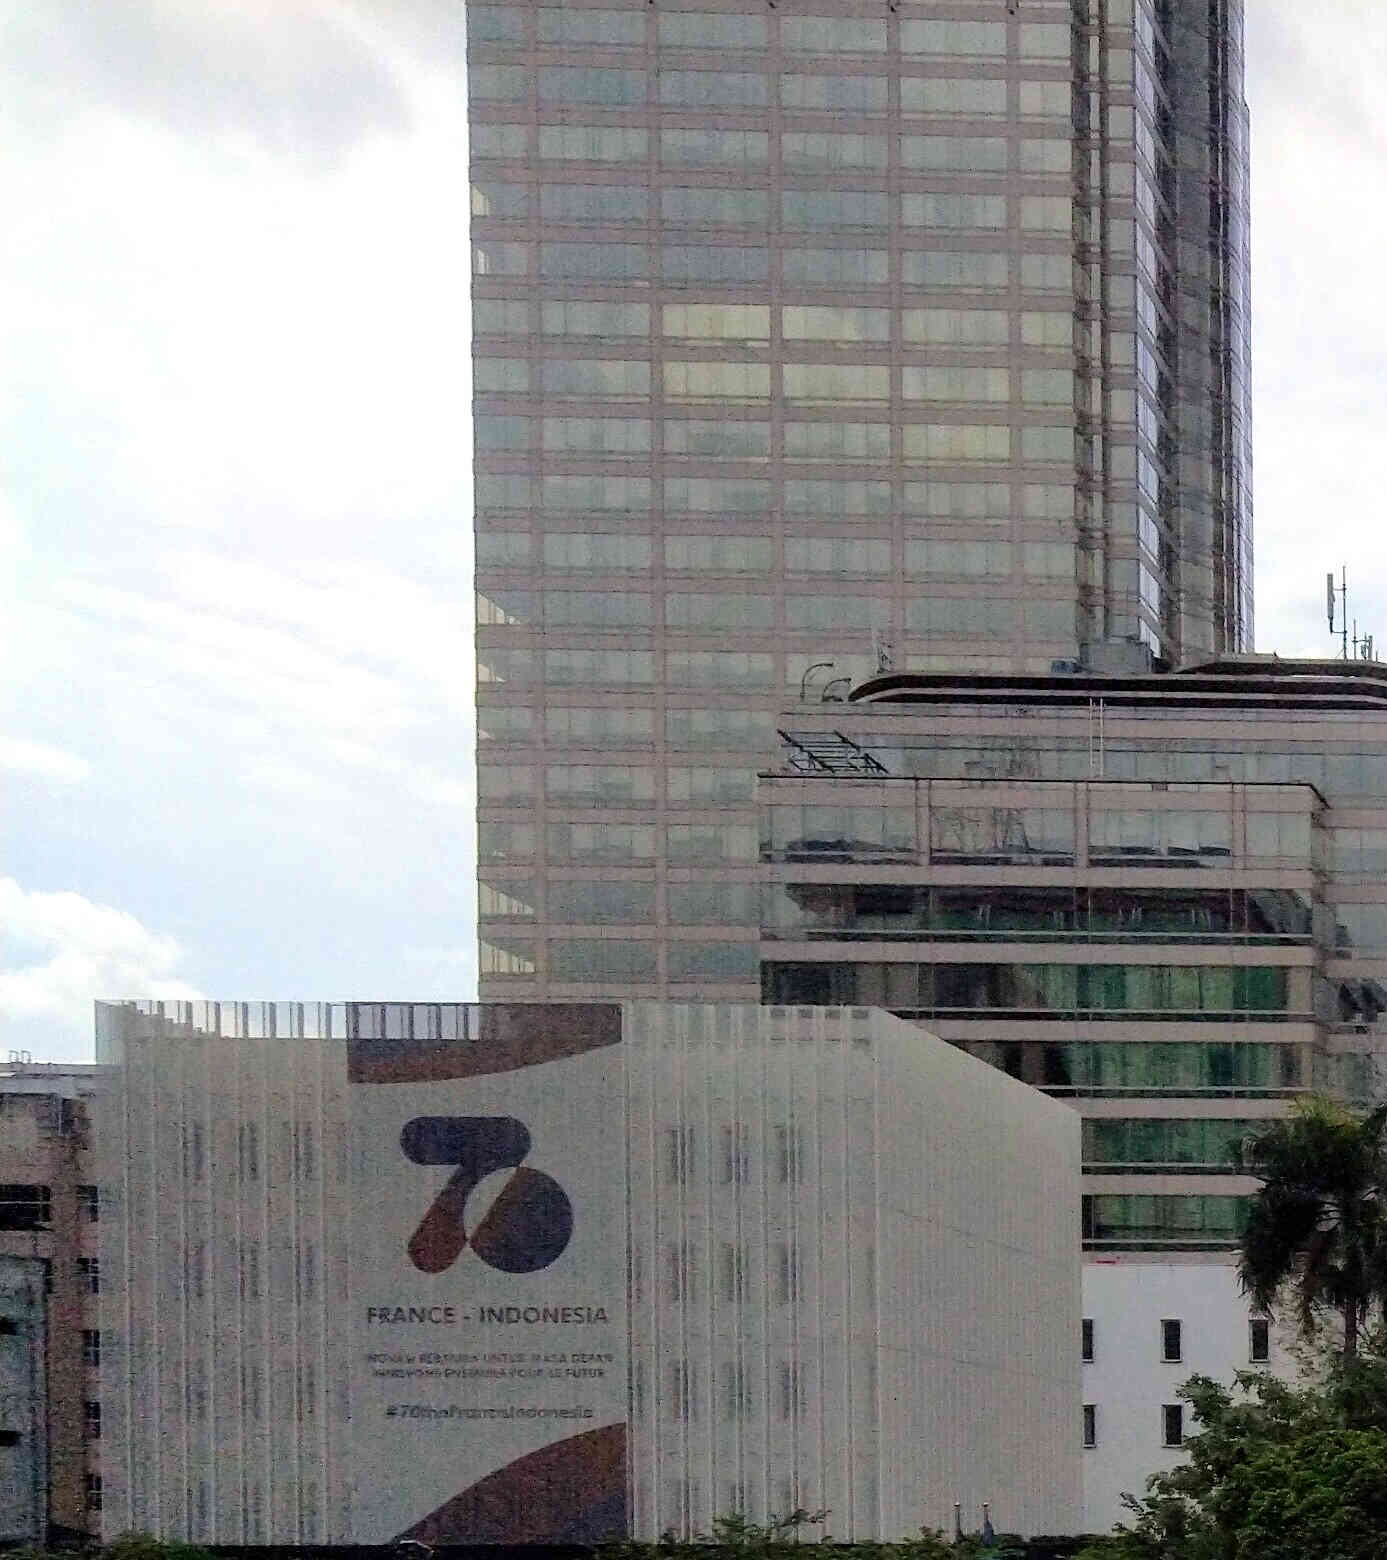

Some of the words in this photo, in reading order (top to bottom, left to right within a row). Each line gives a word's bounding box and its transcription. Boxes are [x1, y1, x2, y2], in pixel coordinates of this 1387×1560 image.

[400, 1116, 573, 1273] 70
[367, 1306, 457, 1324] FRANCE
[479, 1306, 608, 1324] INDONESIA
